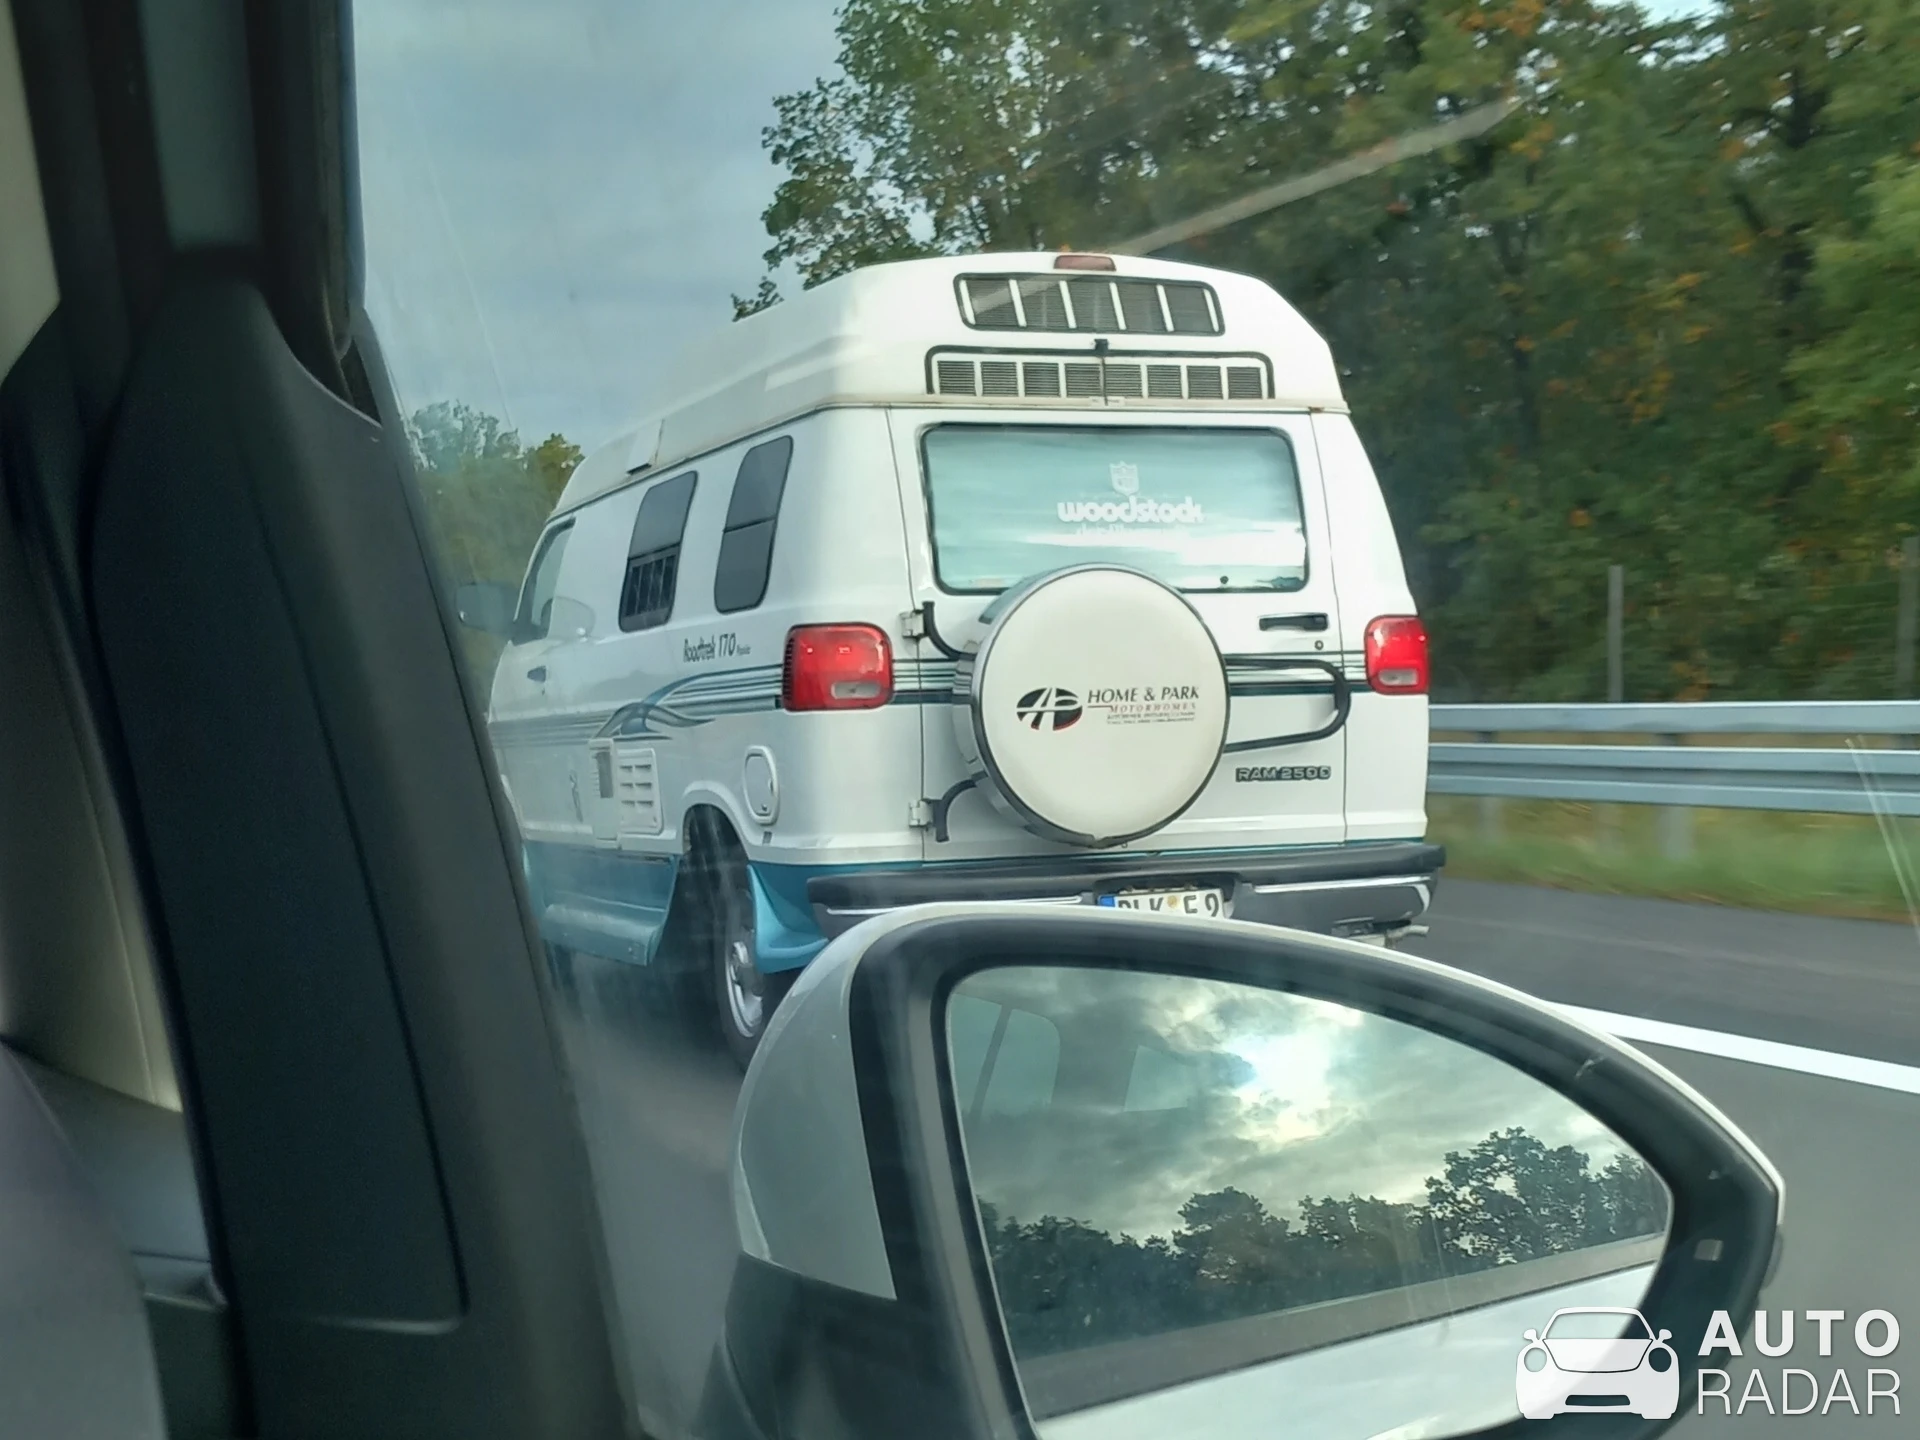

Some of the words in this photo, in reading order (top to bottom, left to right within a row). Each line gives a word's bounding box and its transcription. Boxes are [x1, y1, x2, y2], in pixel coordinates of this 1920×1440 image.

[1057, 496, 1205, 523] woodstock
[719, 632, 736, 657] 170
[1087, 687, 1139, 704] HOME
[1143, 687, 1156, 701] &
[1161, 686, 1199, 700] PARK
[1235, 767, 1279, 783] RAM
[1279, 765, 1332, 781] 2500
